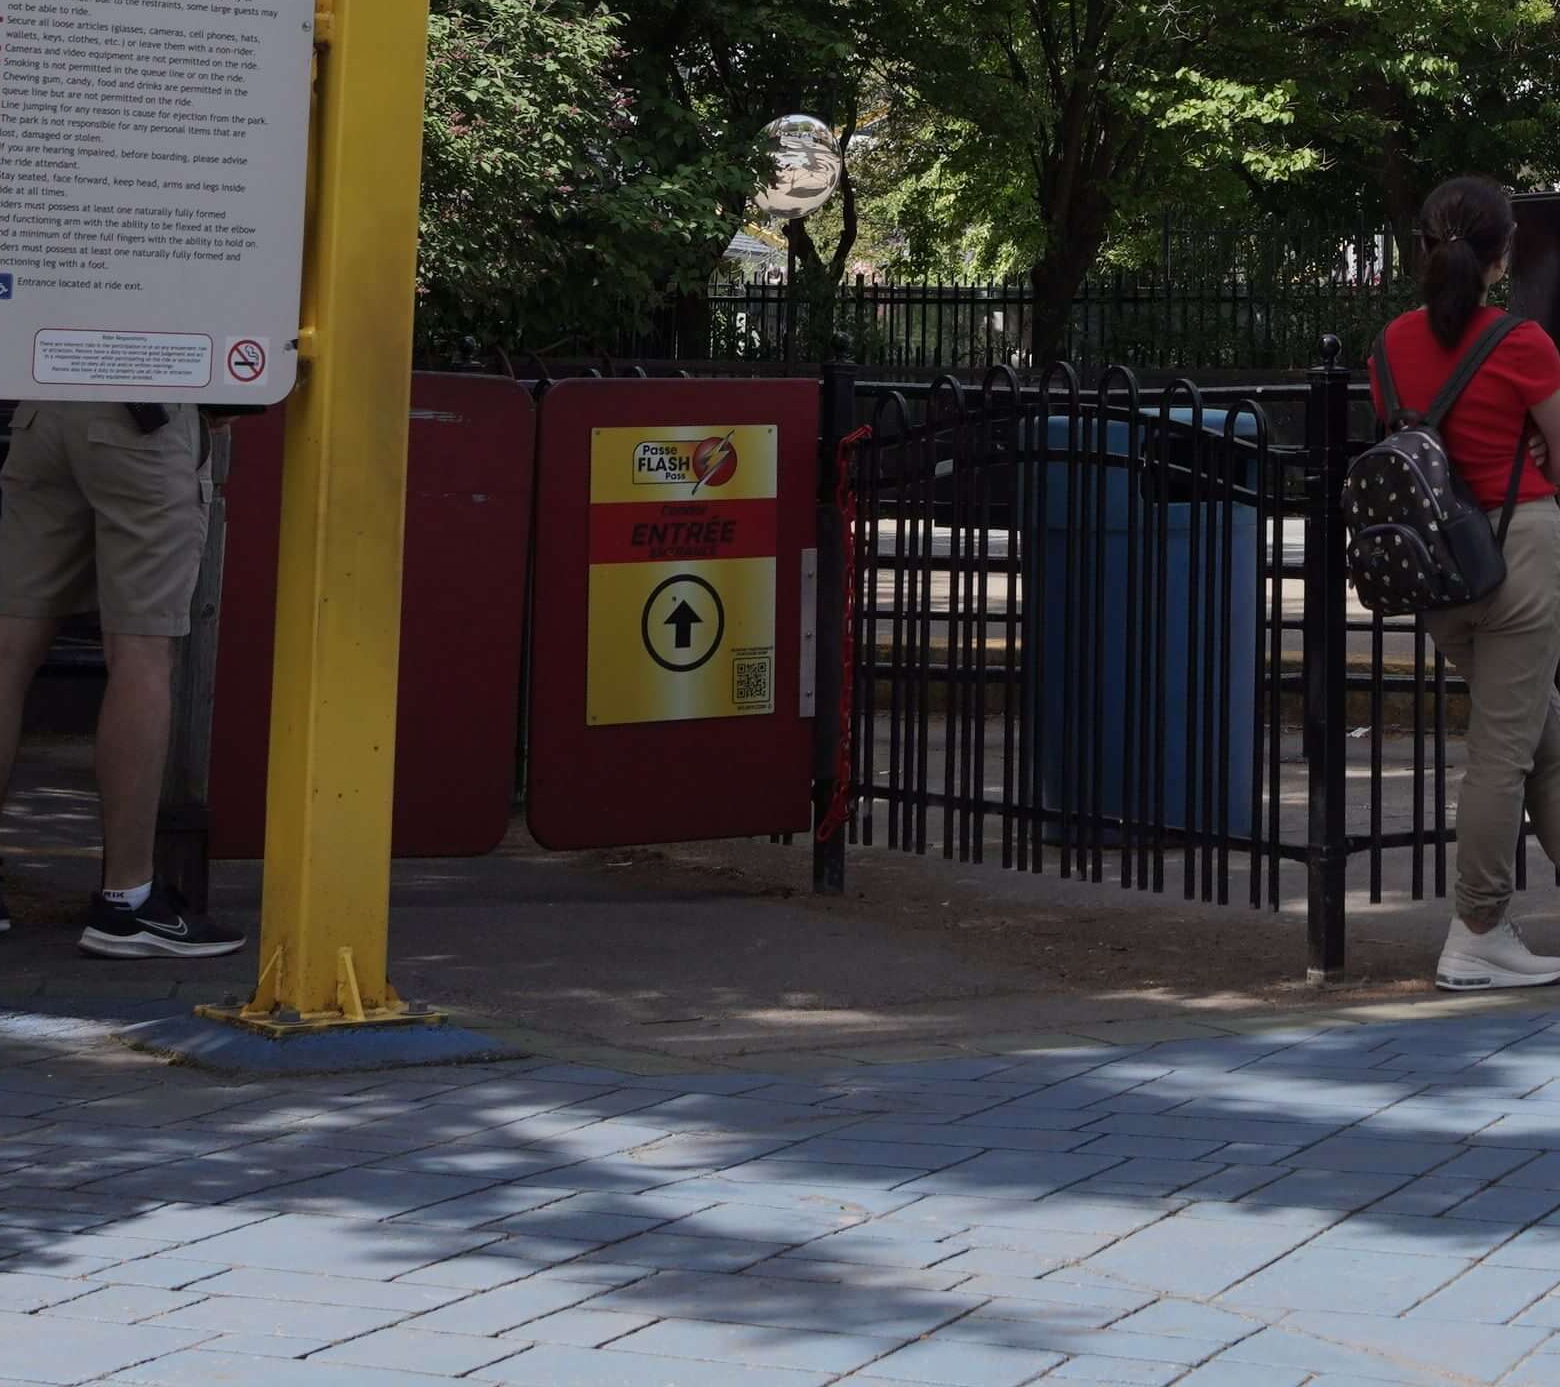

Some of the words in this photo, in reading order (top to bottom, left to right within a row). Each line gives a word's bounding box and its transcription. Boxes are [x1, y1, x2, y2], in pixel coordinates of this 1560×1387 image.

[4, 43, 43, 55] Cameras
[44, 47, 61, 56] and
[62, 48, 87, 58] video
[87, 50, 134, 61] equipment
[135, 54, 151, 63] are
[152, 55, 167, 64] not
[168, 57, 211, 67] permitted
[211, 60, 223, 68] on
[224, 60, 239, 69] the
[240, 61, 260, 70] ride.
[3, 57, 41, 71] Smoking
[42, 61, 50, 69] is
[51, 62, 67, 71] not
[68, 63, 112, 74] permitted
[114, 66, 122, 74] in
[124, 66, 139, 76] the
[140, 68, 167, 78] queue
[168, 69, 185, 79] line
[186, 72, 197, 80] or
[210, 72, 225, 82] the
[226, 74, 246, 83] ride.
[15, 186, 25, 196] at
[27, 186, 39, 196] all
[41, 187, 67, 197] times.
[17, 276, 57, 288] Entrance
[58, 278, 92, 289] located
[93, 281, 102, 290] at
[104, 281, 122, 290] ride
[124, 282, 143, 291] exit.
[643, 444, 678, 456] Passe
[638, 457, 690, 472] FLASH
[665, 471, 686, 480] Pass
[631, 516, 737, 546] ENTRÉE
